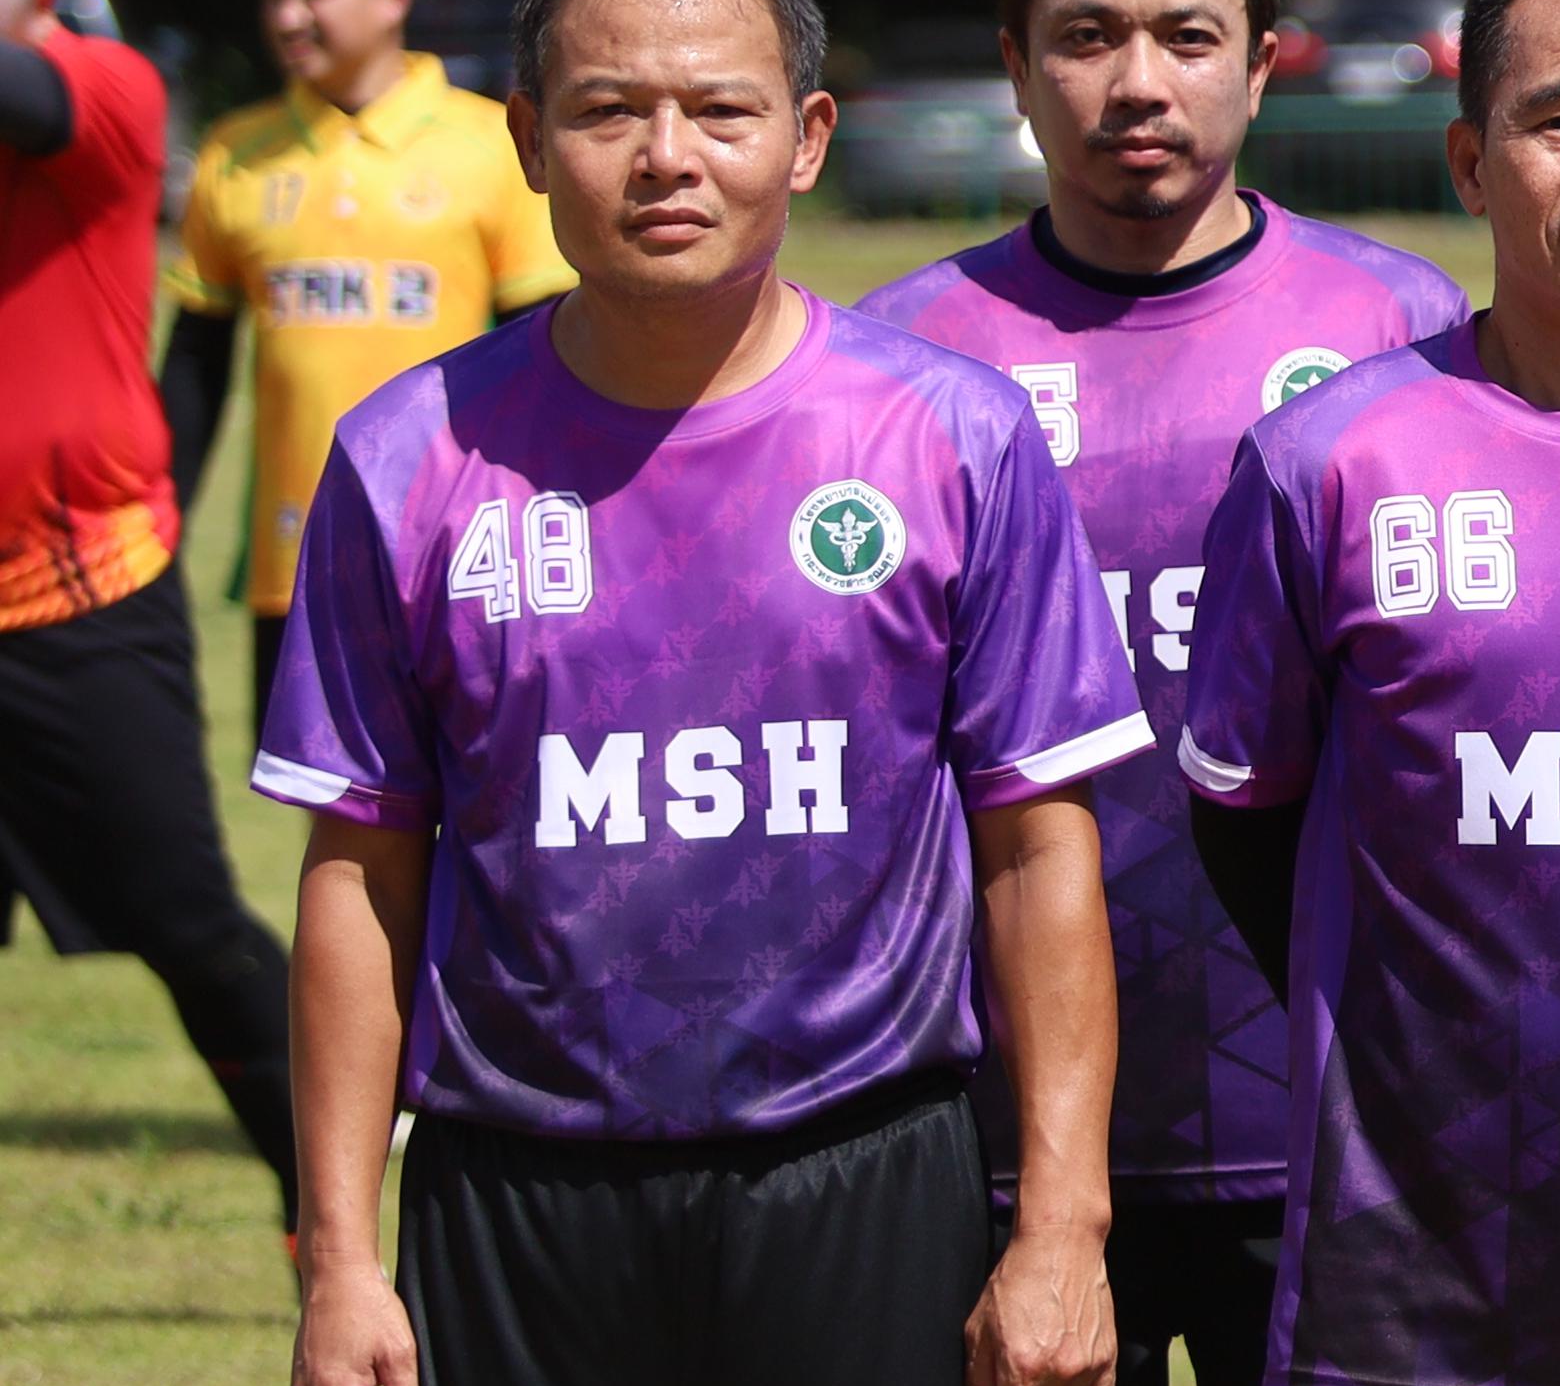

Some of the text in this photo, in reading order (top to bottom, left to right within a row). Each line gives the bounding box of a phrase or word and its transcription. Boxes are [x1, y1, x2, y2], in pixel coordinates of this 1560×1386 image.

[997, 362, 1080, 467] 5
[448, 491, 594, 623] 48
[1369, 489, 1516, 619] 66
[535, 720, 849, 847] MSH
